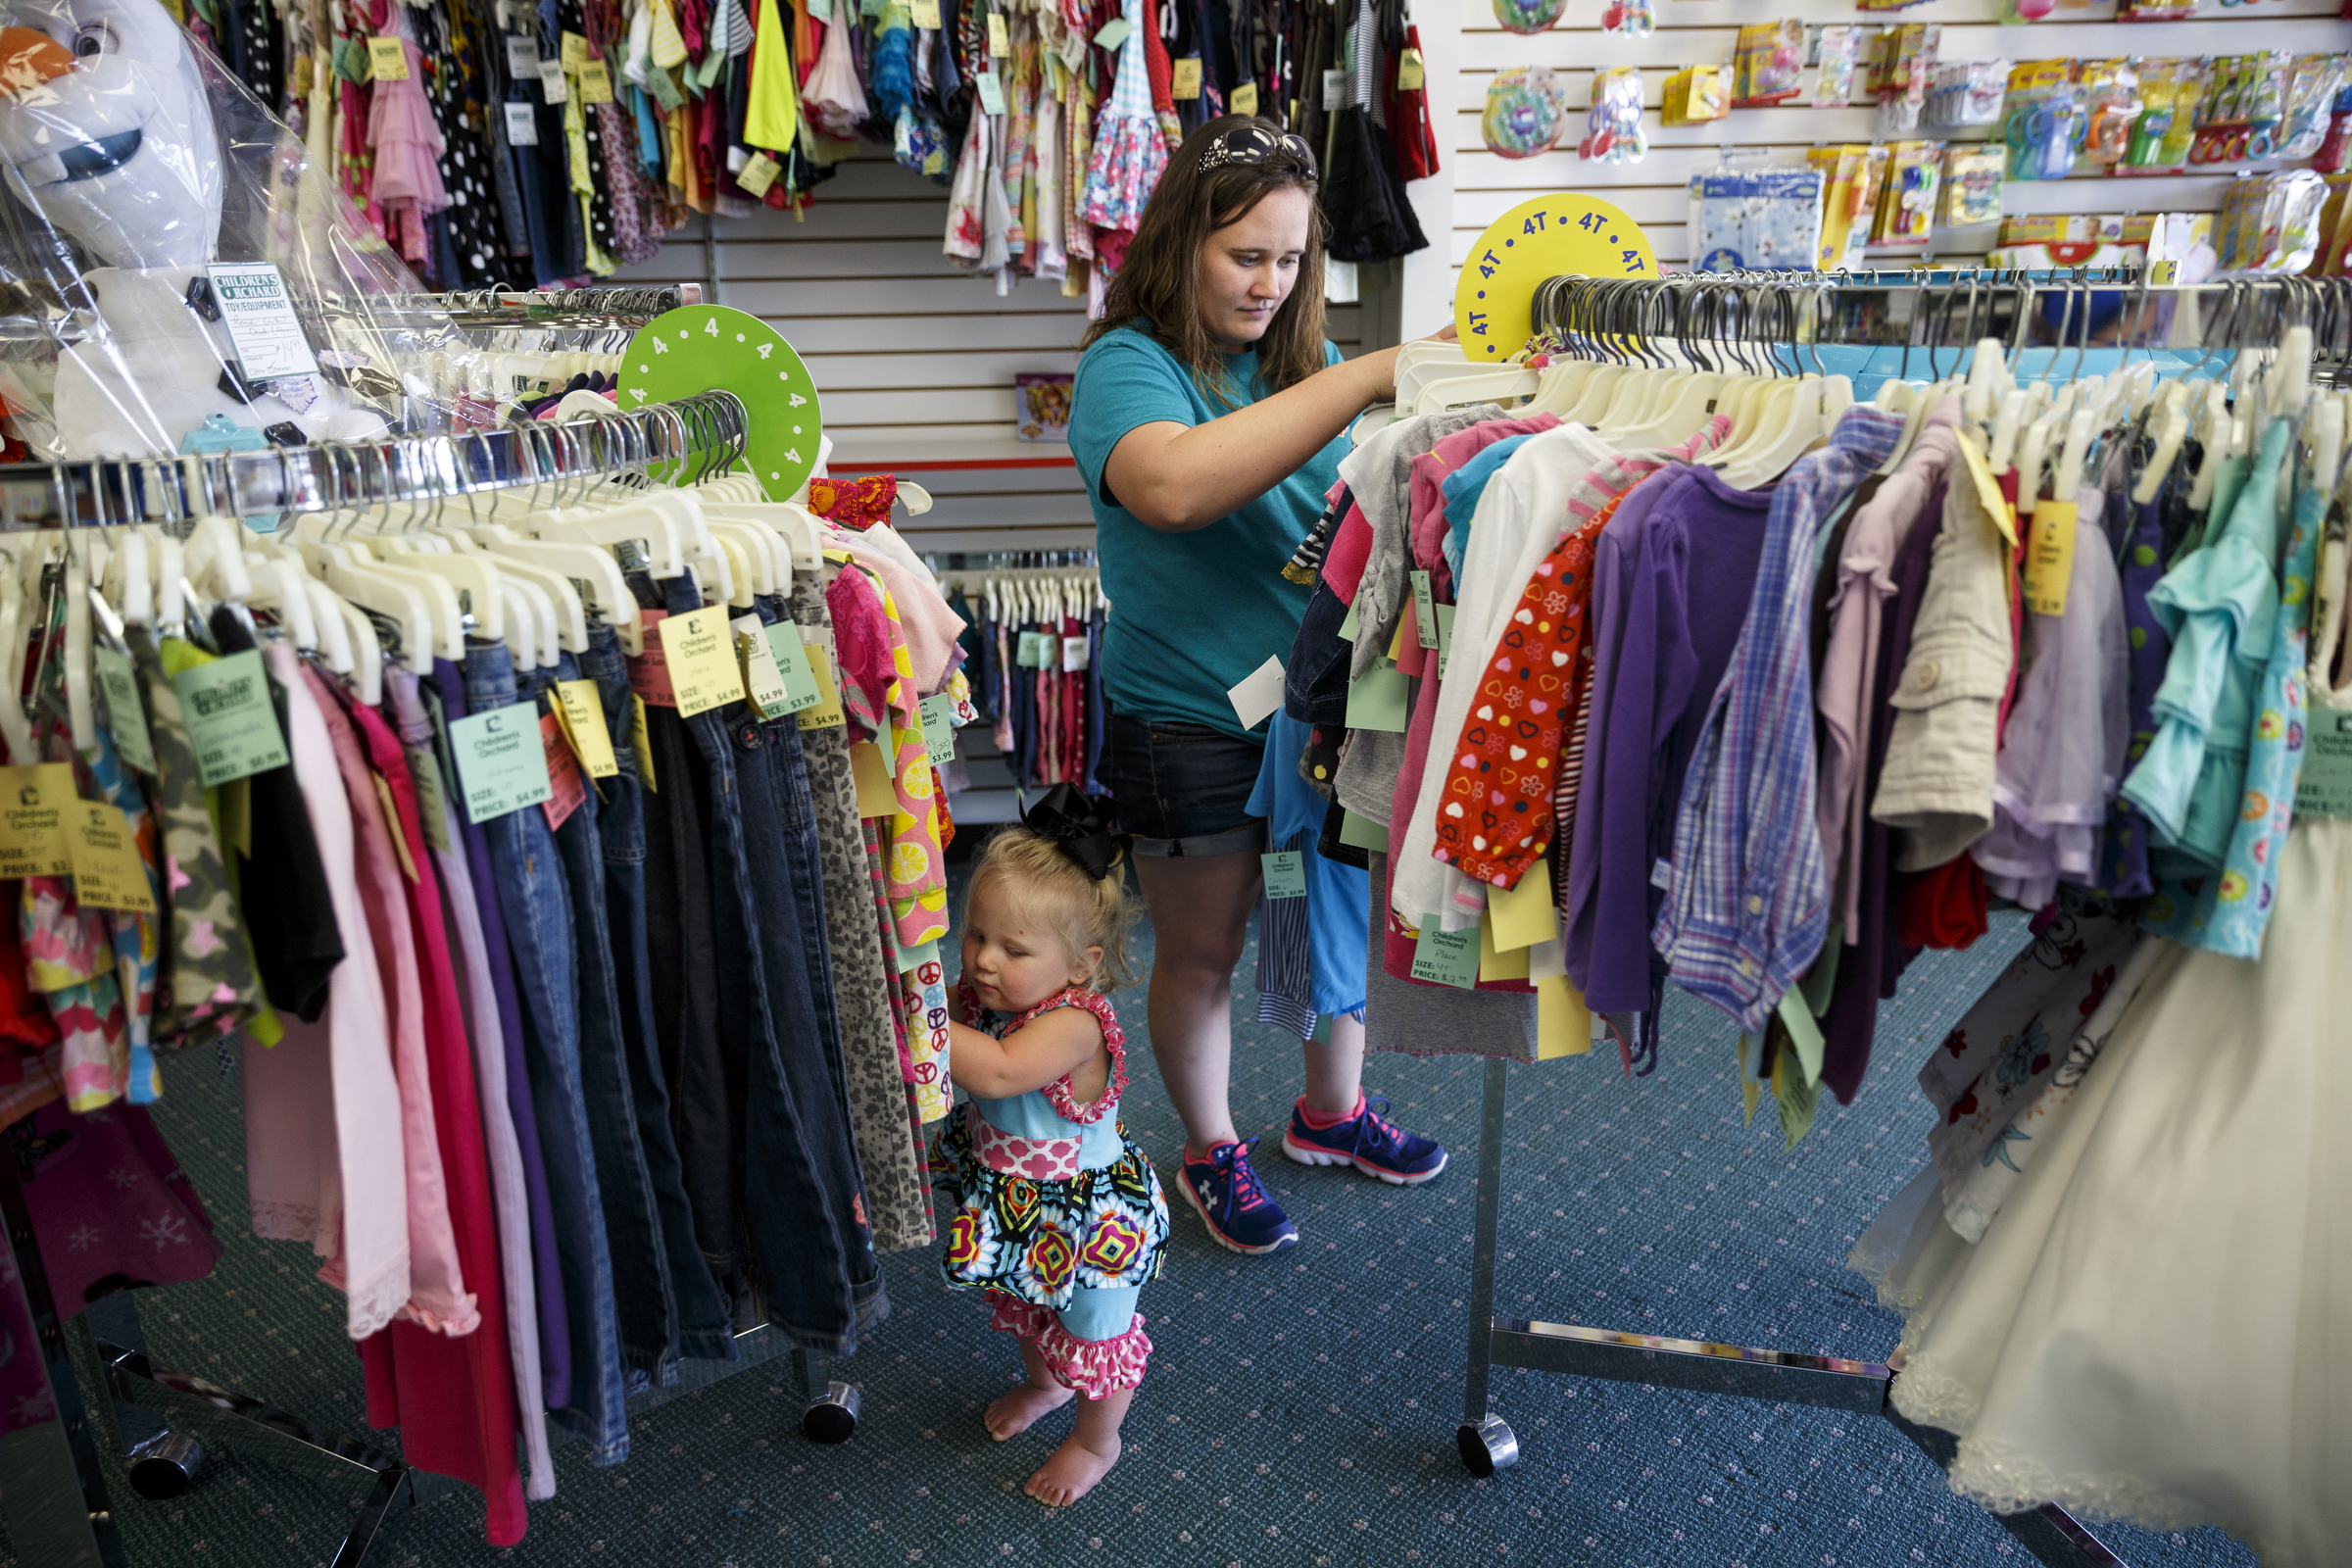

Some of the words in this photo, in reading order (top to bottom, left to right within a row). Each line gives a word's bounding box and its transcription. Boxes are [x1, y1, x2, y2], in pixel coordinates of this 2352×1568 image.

[1469, 311, 1488, 335] 4T
[1479, 249, 1500, 279] 4T
[1523, 211, 1546, 234] 4T
[1579, 212, 1608, 233] 4T
[1622, 250, 1644, 272] 4T
[214, 273, 279, 288] CHILDREN'S
[220, 286, 280, 300] ORCHARD
[224, 300, 286, 313] TOY/EQUIPMENT
[705, 318, 719, 338] 4
[652, 336, 668, 355] 4
[757, 343, 773, 360] 4
[629, 388, 648, 403] 4
[789, 393, 807, 408] 4
[784, 448, 802, 465] 4
[679, 633, 716, 651] Children's
[684, 643, 716, 659] Orchard
[679, 686, 702, 700] SIZE:
[760, 689, 783, 703] $4.99
[684, 697, 711, 713] PRICE:
[716, 688, 740, 703] $4.99
[790, 694, 815, 709] $3.99
[815, 713, 839, 725] $4.99
[473, 730, 520, 751] Children's
[478, 741, 519, 760] Orchard
[932, 751, 952, 762] $3.99
[593, 762, 613, 774] $4.99
[470, 788, 497, 803] SIZE:
[474, 800, 509, 816] PRICE:
[515, 787, 546, 804] $4.99
[6, 808, 60, 819] Children's
[12, 818, 58, 830] Orchard
[3, 862, 42, 874] PRICE:
[52, 861, 73, 872] $2.
[80, 874, 106, 886] SIZE:
[82, 891, 116, 903] PRICE:
[1432, 931, 1467, 944] Children's
[1433, 938, 1464, 950] Orchard
[1435, 948, 1457, 960] Place
[1415, 959, 1435, 969] SIZE:
[1413, 969, 1439, 980] PRICE:
